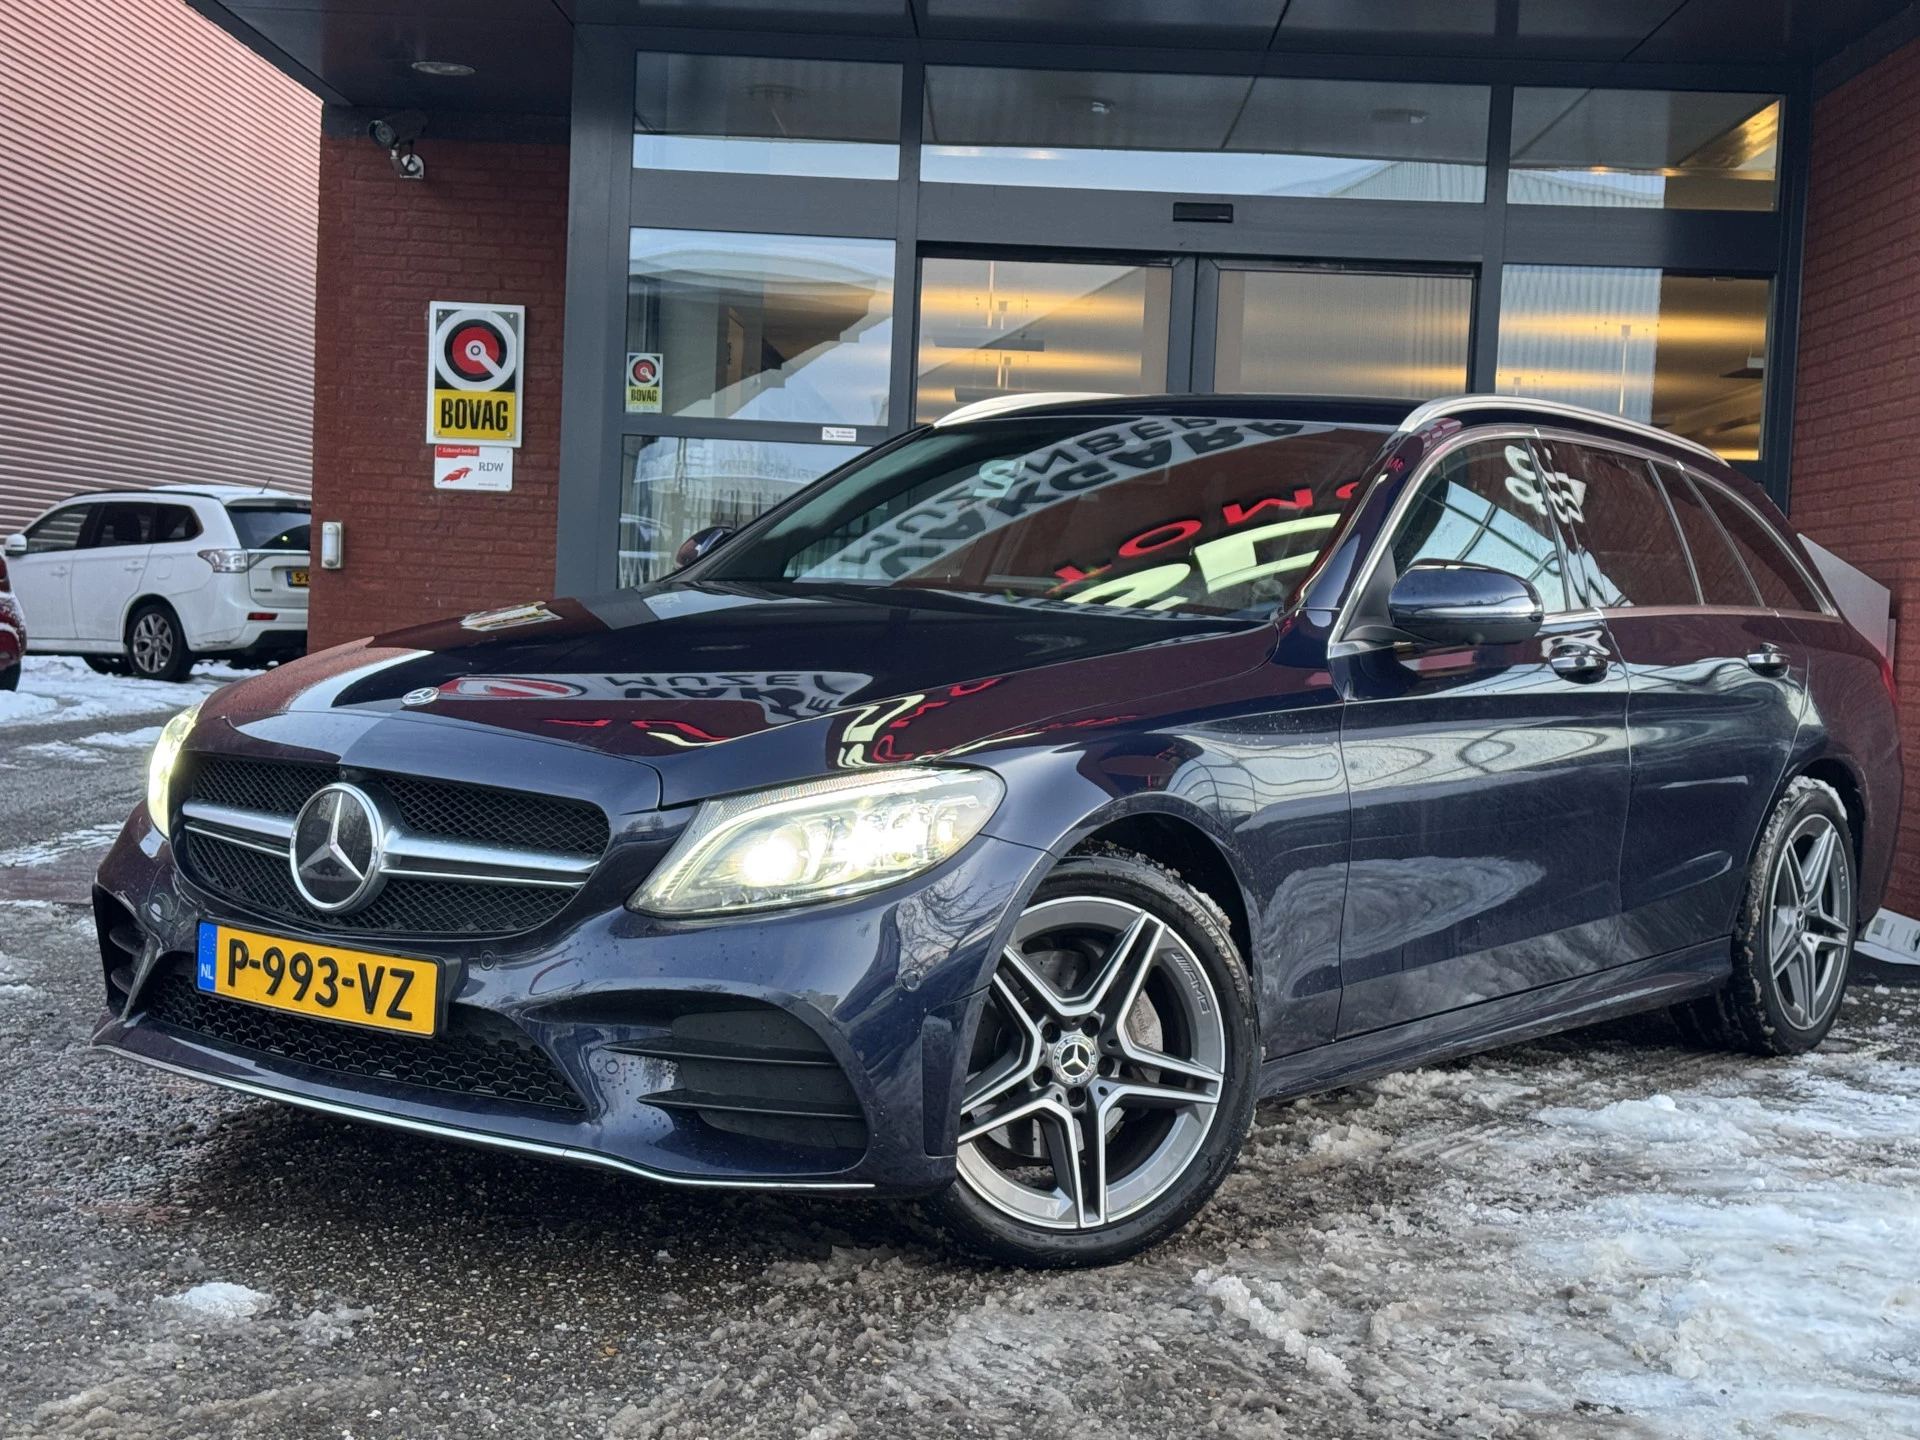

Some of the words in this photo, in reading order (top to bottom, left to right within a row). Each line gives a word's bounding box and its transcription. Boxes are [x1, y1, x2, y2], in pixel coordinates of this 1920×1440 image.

[631, 389, 657, 402] BOVAG
[441, 397, 509, 432] BOVAG
[478, 461, 504, 472] RDW
[201, 963, 214, 980] NL
[228, 938, 415, 1021] P-993-VZ
